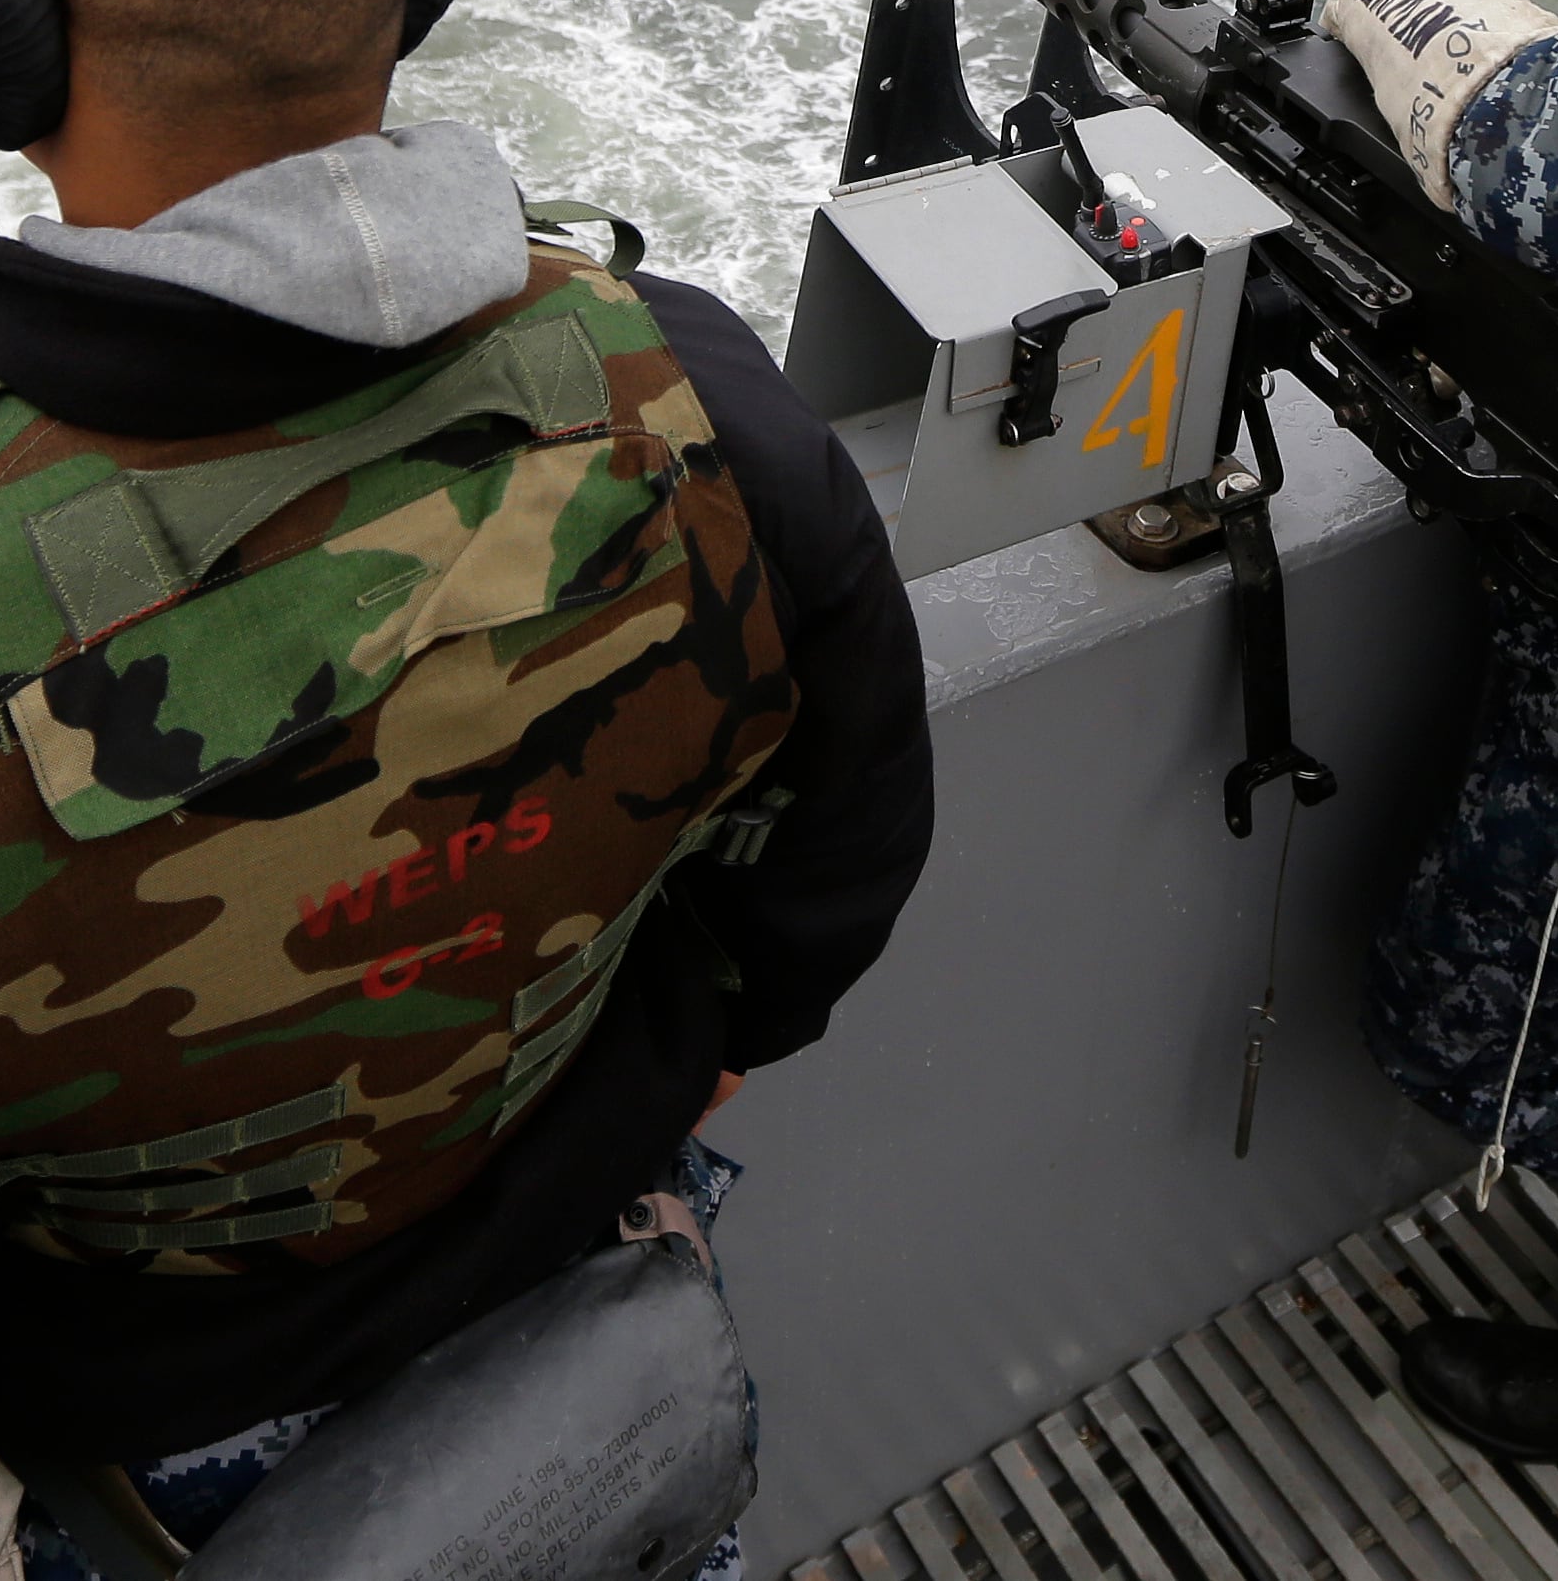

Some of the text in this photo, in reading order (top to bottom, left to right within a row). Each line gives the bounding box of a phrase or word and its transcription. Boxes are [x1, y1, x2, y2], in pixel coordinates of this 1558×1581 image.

[297, 796, 552, 938] WEPS
[481, 1485, 526, 1531] JUNE
[528, 1453, 567, 1489] 1995
[535, 1476, 642, 1571] SPECIALISTS
